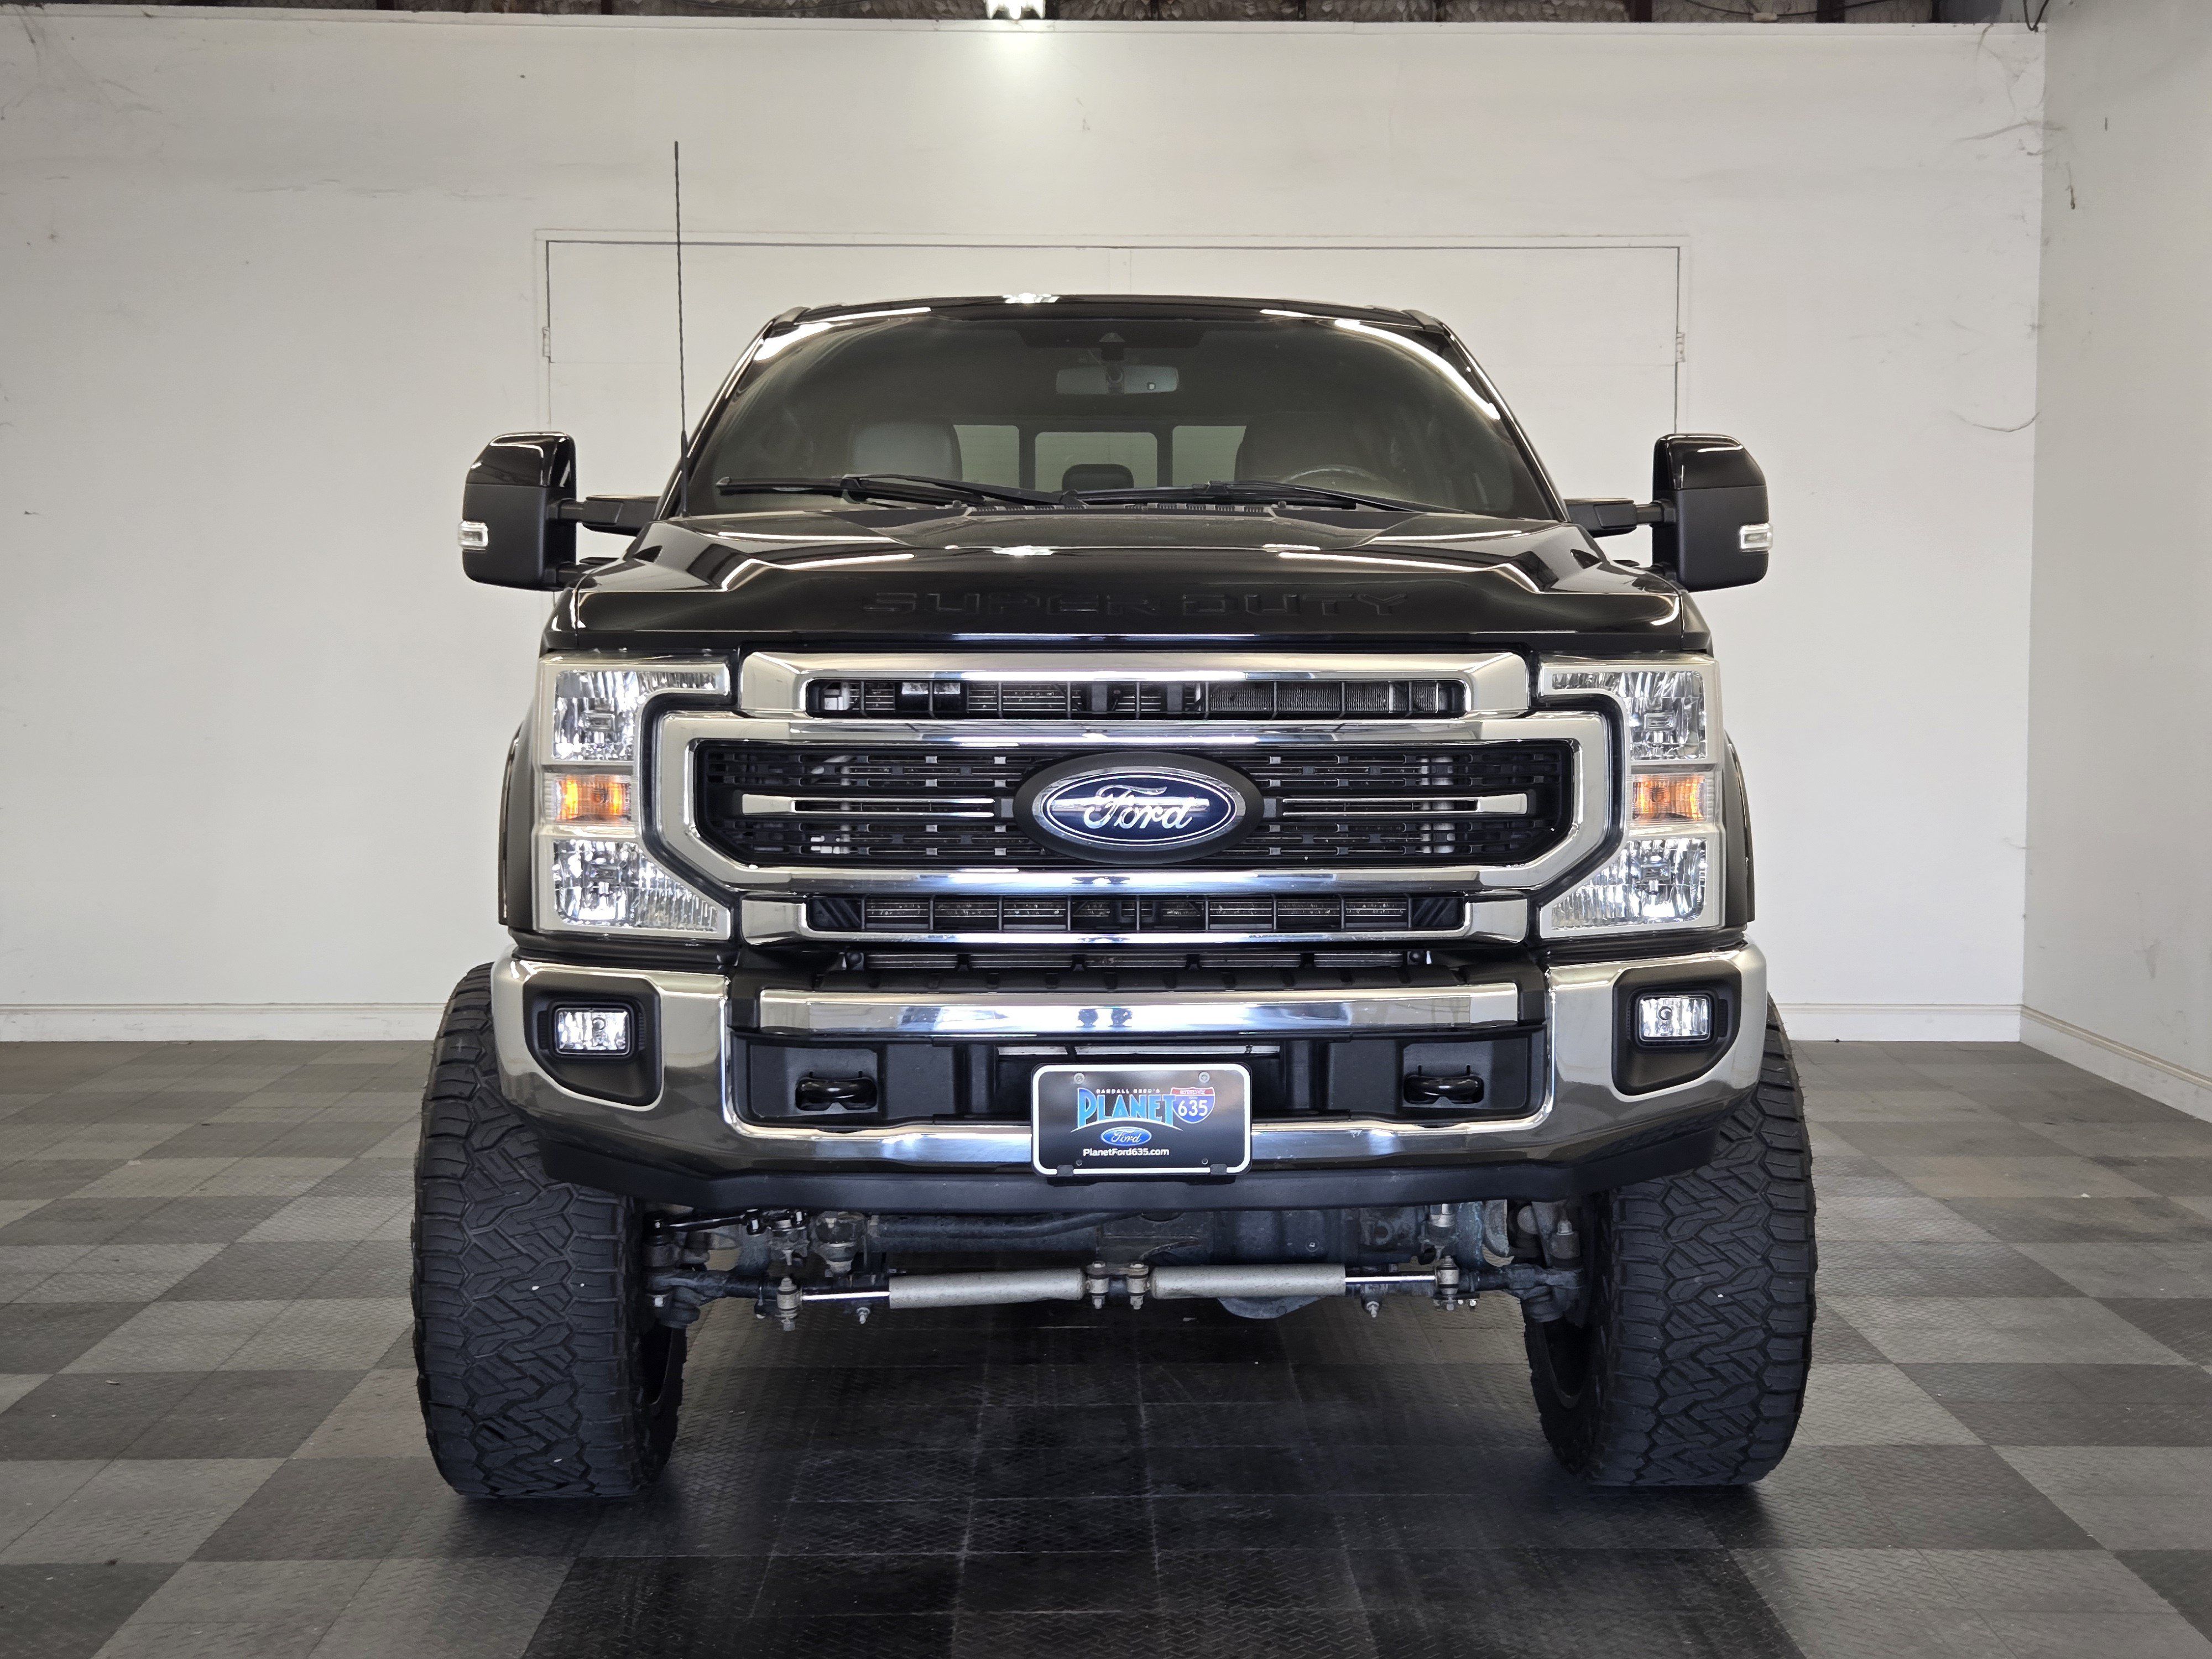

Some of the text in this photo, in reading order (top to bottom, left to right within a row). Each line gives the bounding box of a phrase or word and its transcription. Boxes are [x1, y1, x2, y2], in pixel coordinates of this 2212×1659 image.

[863, 592, 1408, 616] SUPER DUTY
[1083, 784, 1193, 830] Ford
[1077, 1087, 1177, 1128] PLANET
[1177, 1099, 1208, 1117] 635
[1110, 1130, 1142, 1143] Ford
[1083, 1147, 1170, 1156] PlanetFord635.com
